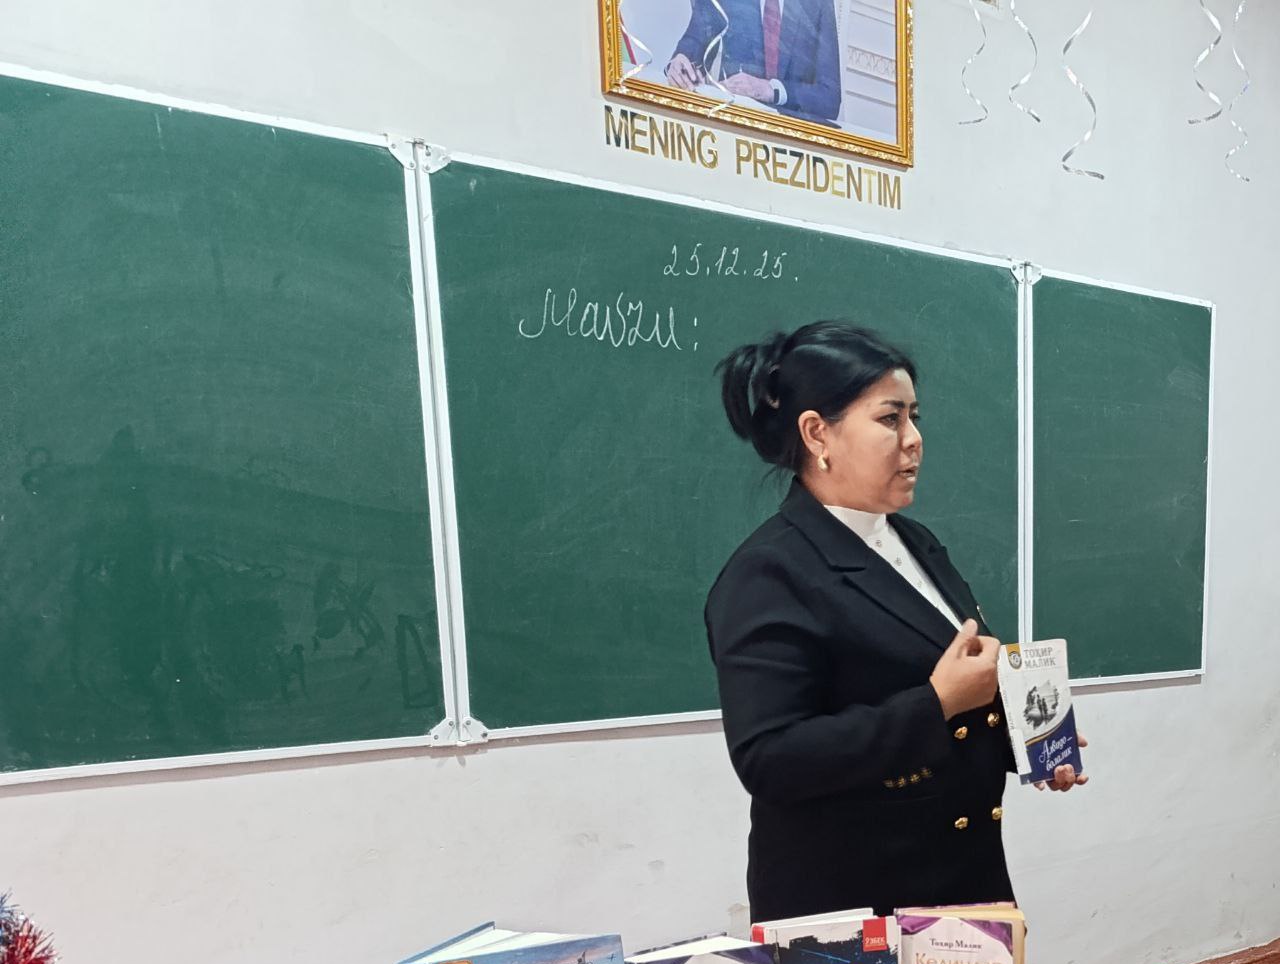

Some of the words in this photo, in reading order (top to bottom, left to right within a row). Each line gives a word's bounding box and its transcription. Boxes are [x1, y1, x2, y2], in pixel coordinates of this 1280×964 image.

[604, 105, 718, 169] MENING
[735, 138, 901, 210] PREZIDENTIM
[1024, 656, 1056, 668] МАЛИК
[955, 939, 982, 950] Малик
